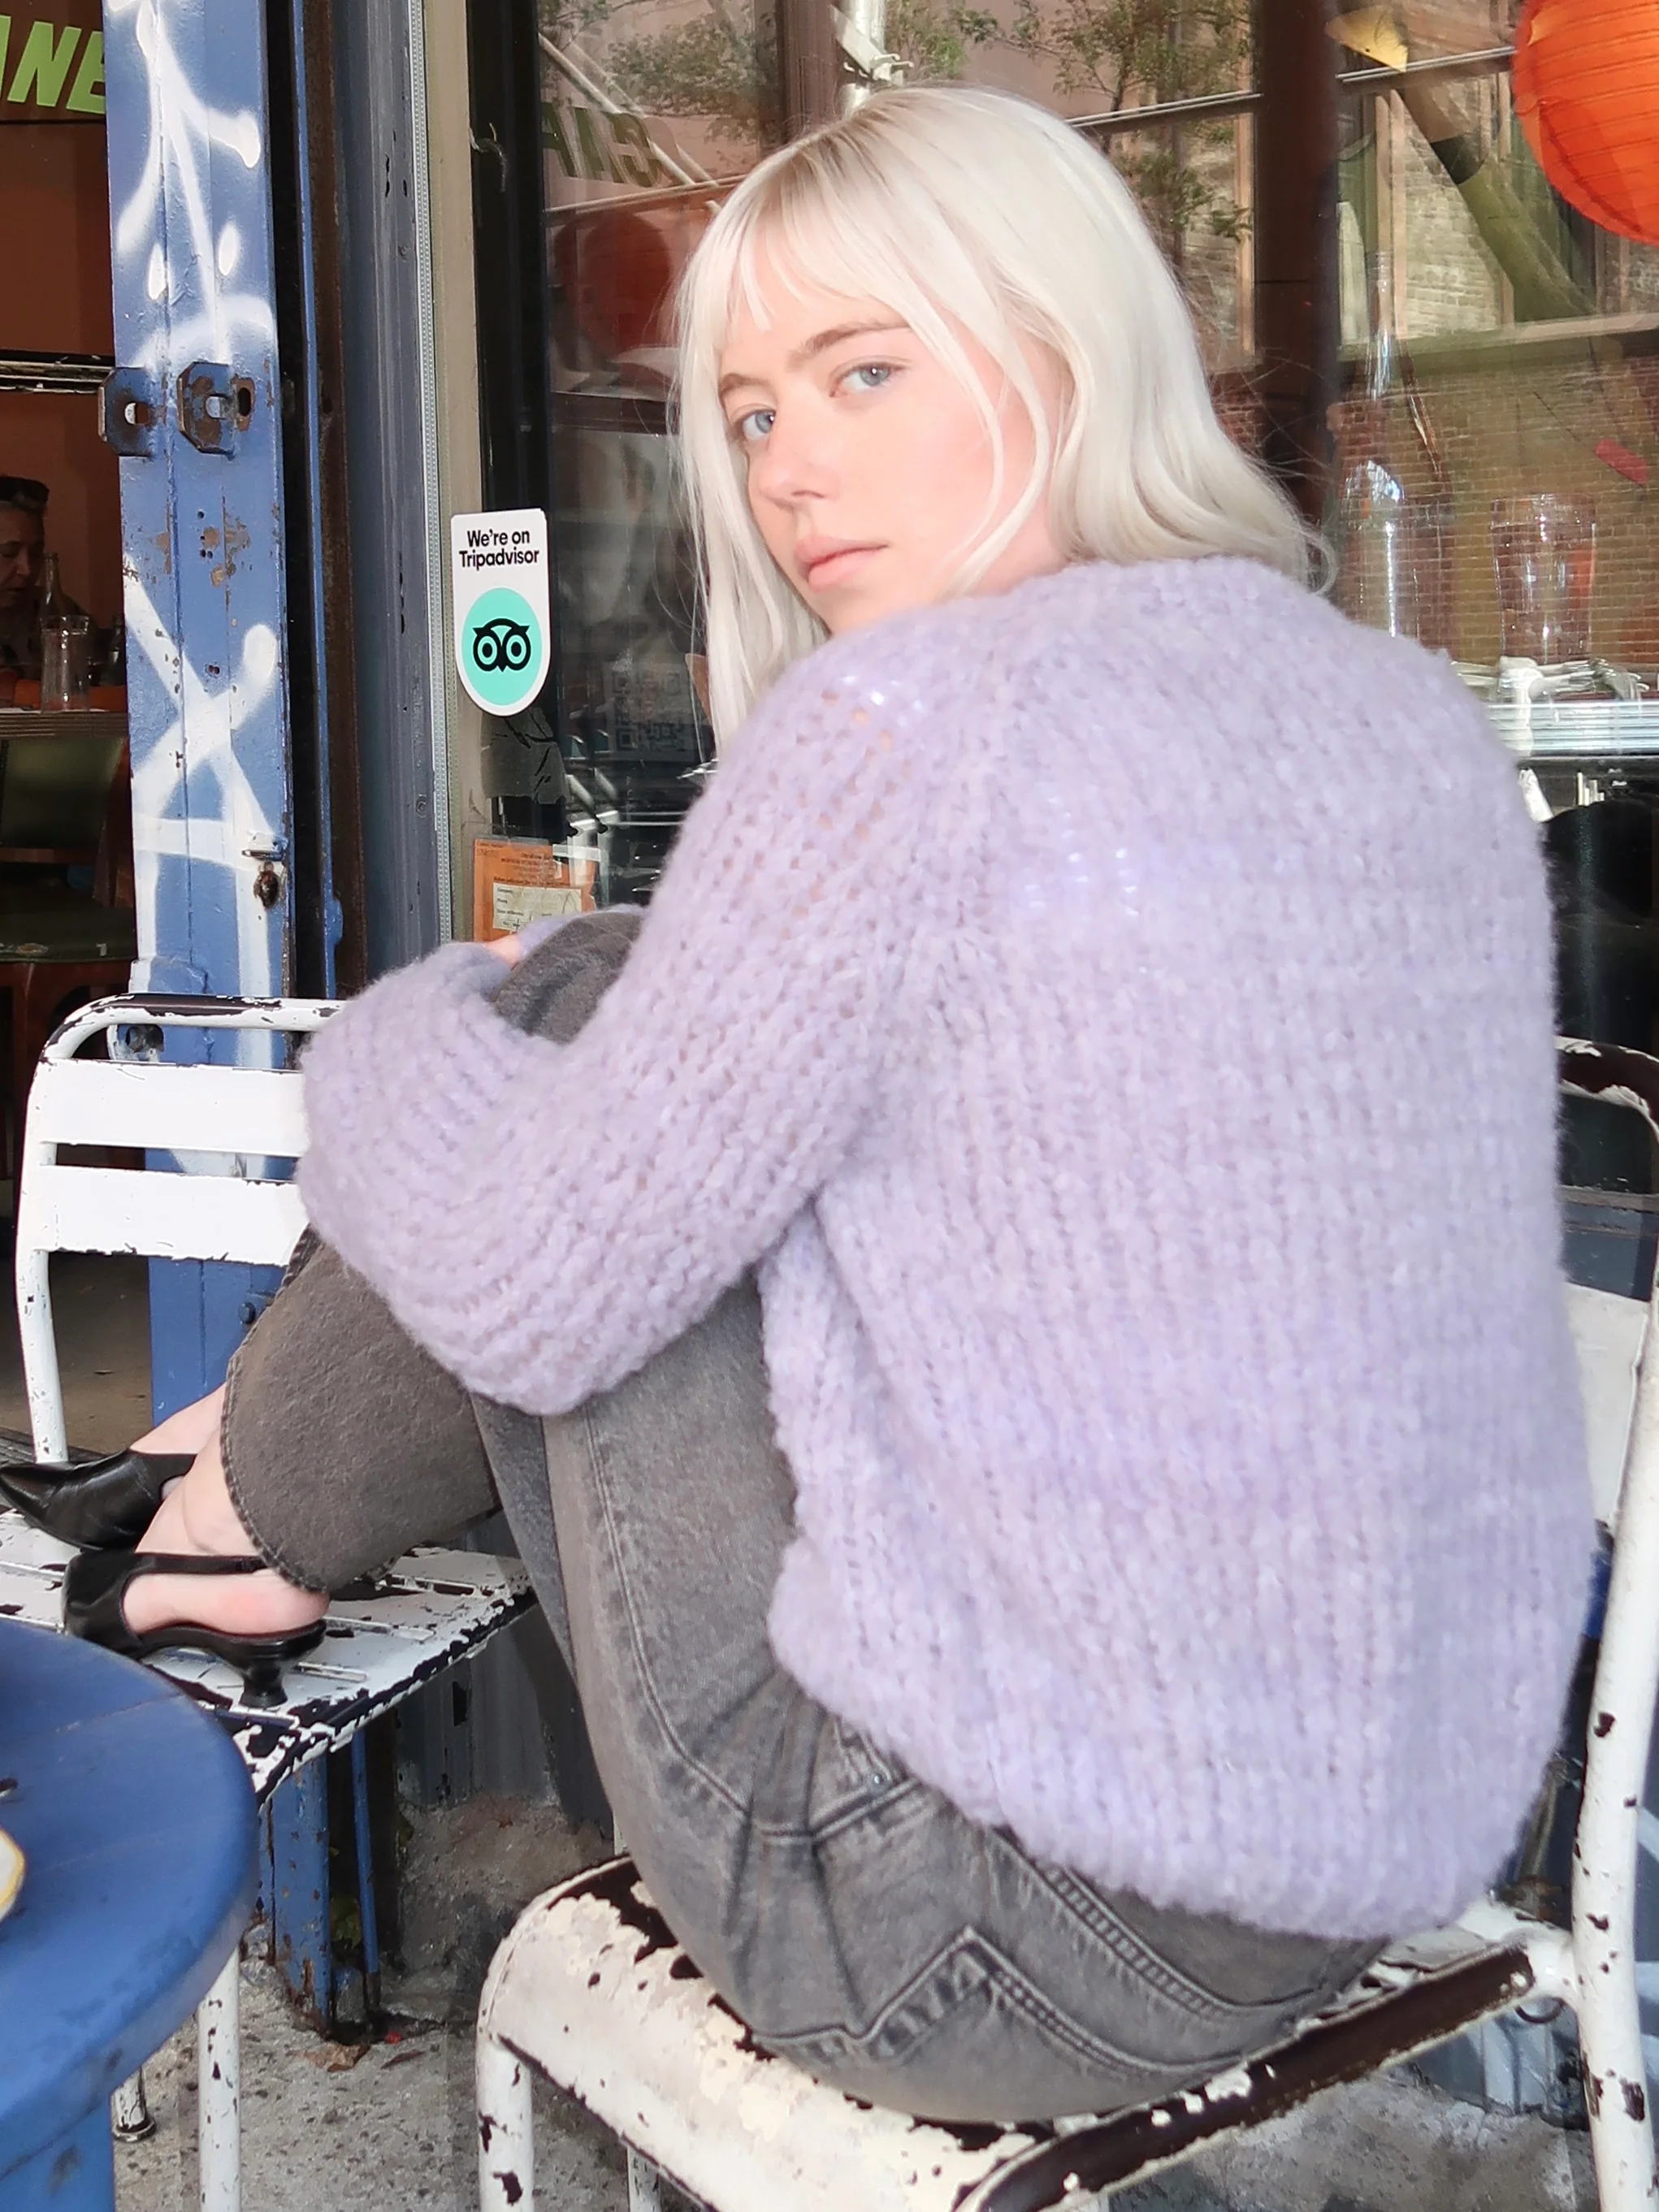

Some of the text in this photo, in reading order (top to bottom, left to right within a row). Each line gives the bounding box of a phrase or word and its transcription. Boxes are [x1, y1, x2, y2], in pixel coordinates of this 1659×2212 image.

[467, 529, 530, 548] We're on
[459, 547, 539, 571] Tripadvisor
